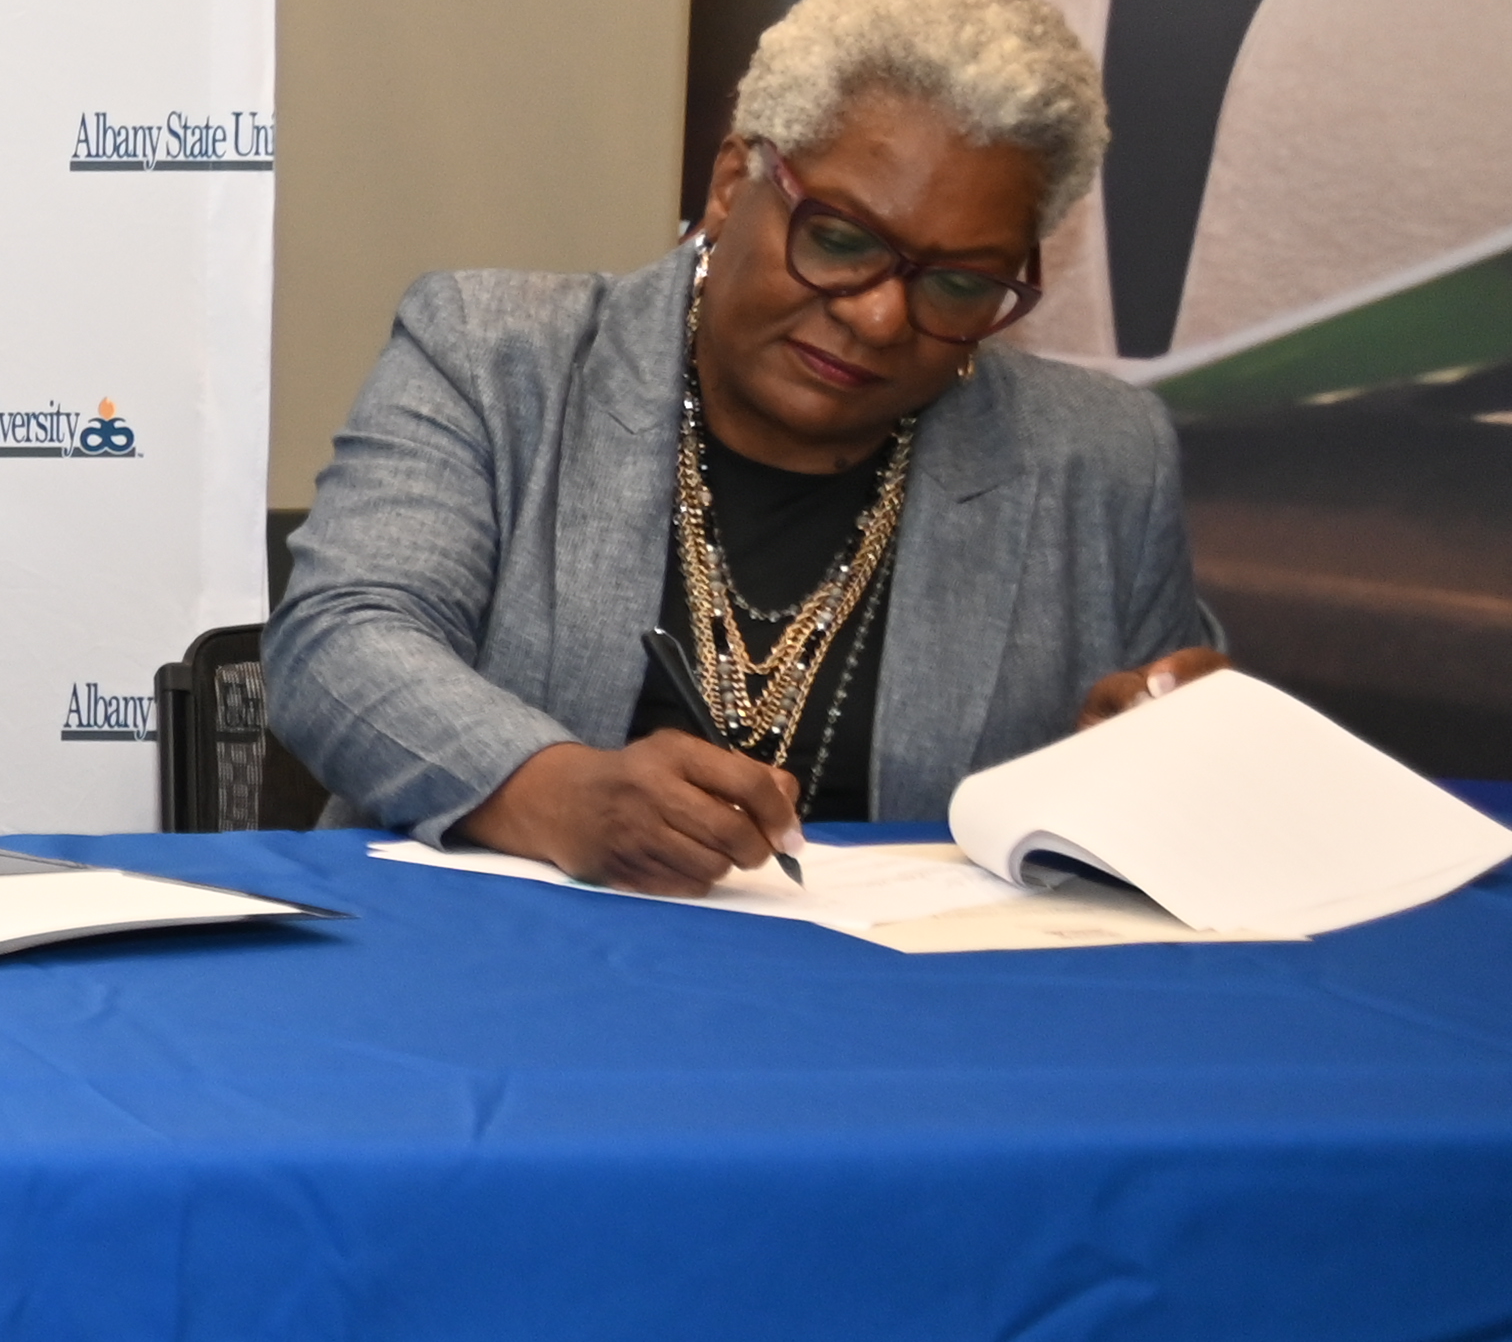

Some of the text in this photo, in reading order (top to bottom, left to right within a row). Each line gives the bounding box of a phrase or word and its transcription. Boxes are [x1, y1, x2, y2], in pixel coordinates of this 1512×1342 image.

[74, 112, 164, 170] Albany
[166, 111, 228, 159] State
[63, 683, 152, 739] Albany
